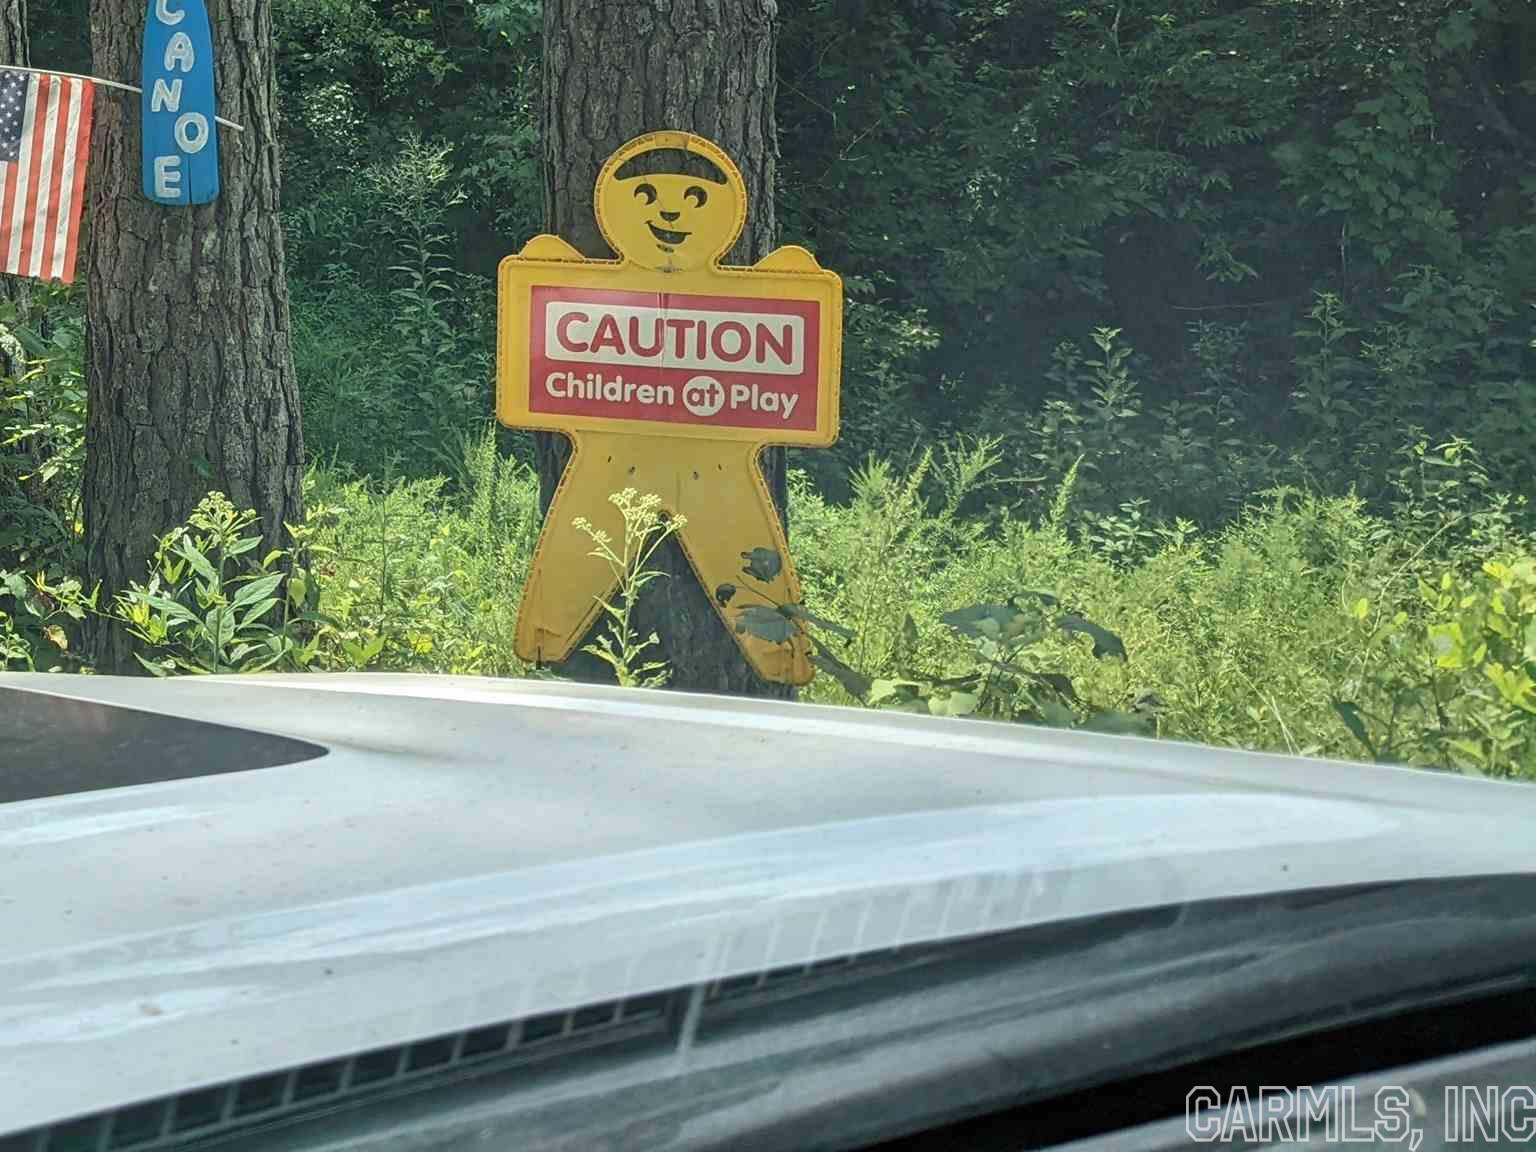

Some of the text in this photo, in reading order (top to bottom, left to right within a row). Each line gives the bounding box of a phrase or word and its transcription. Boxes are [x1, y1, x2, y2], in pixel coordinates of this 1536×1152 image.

[556, 311, 794, 365] CAUTION
[545, 371, 800, 419] Children at Play
